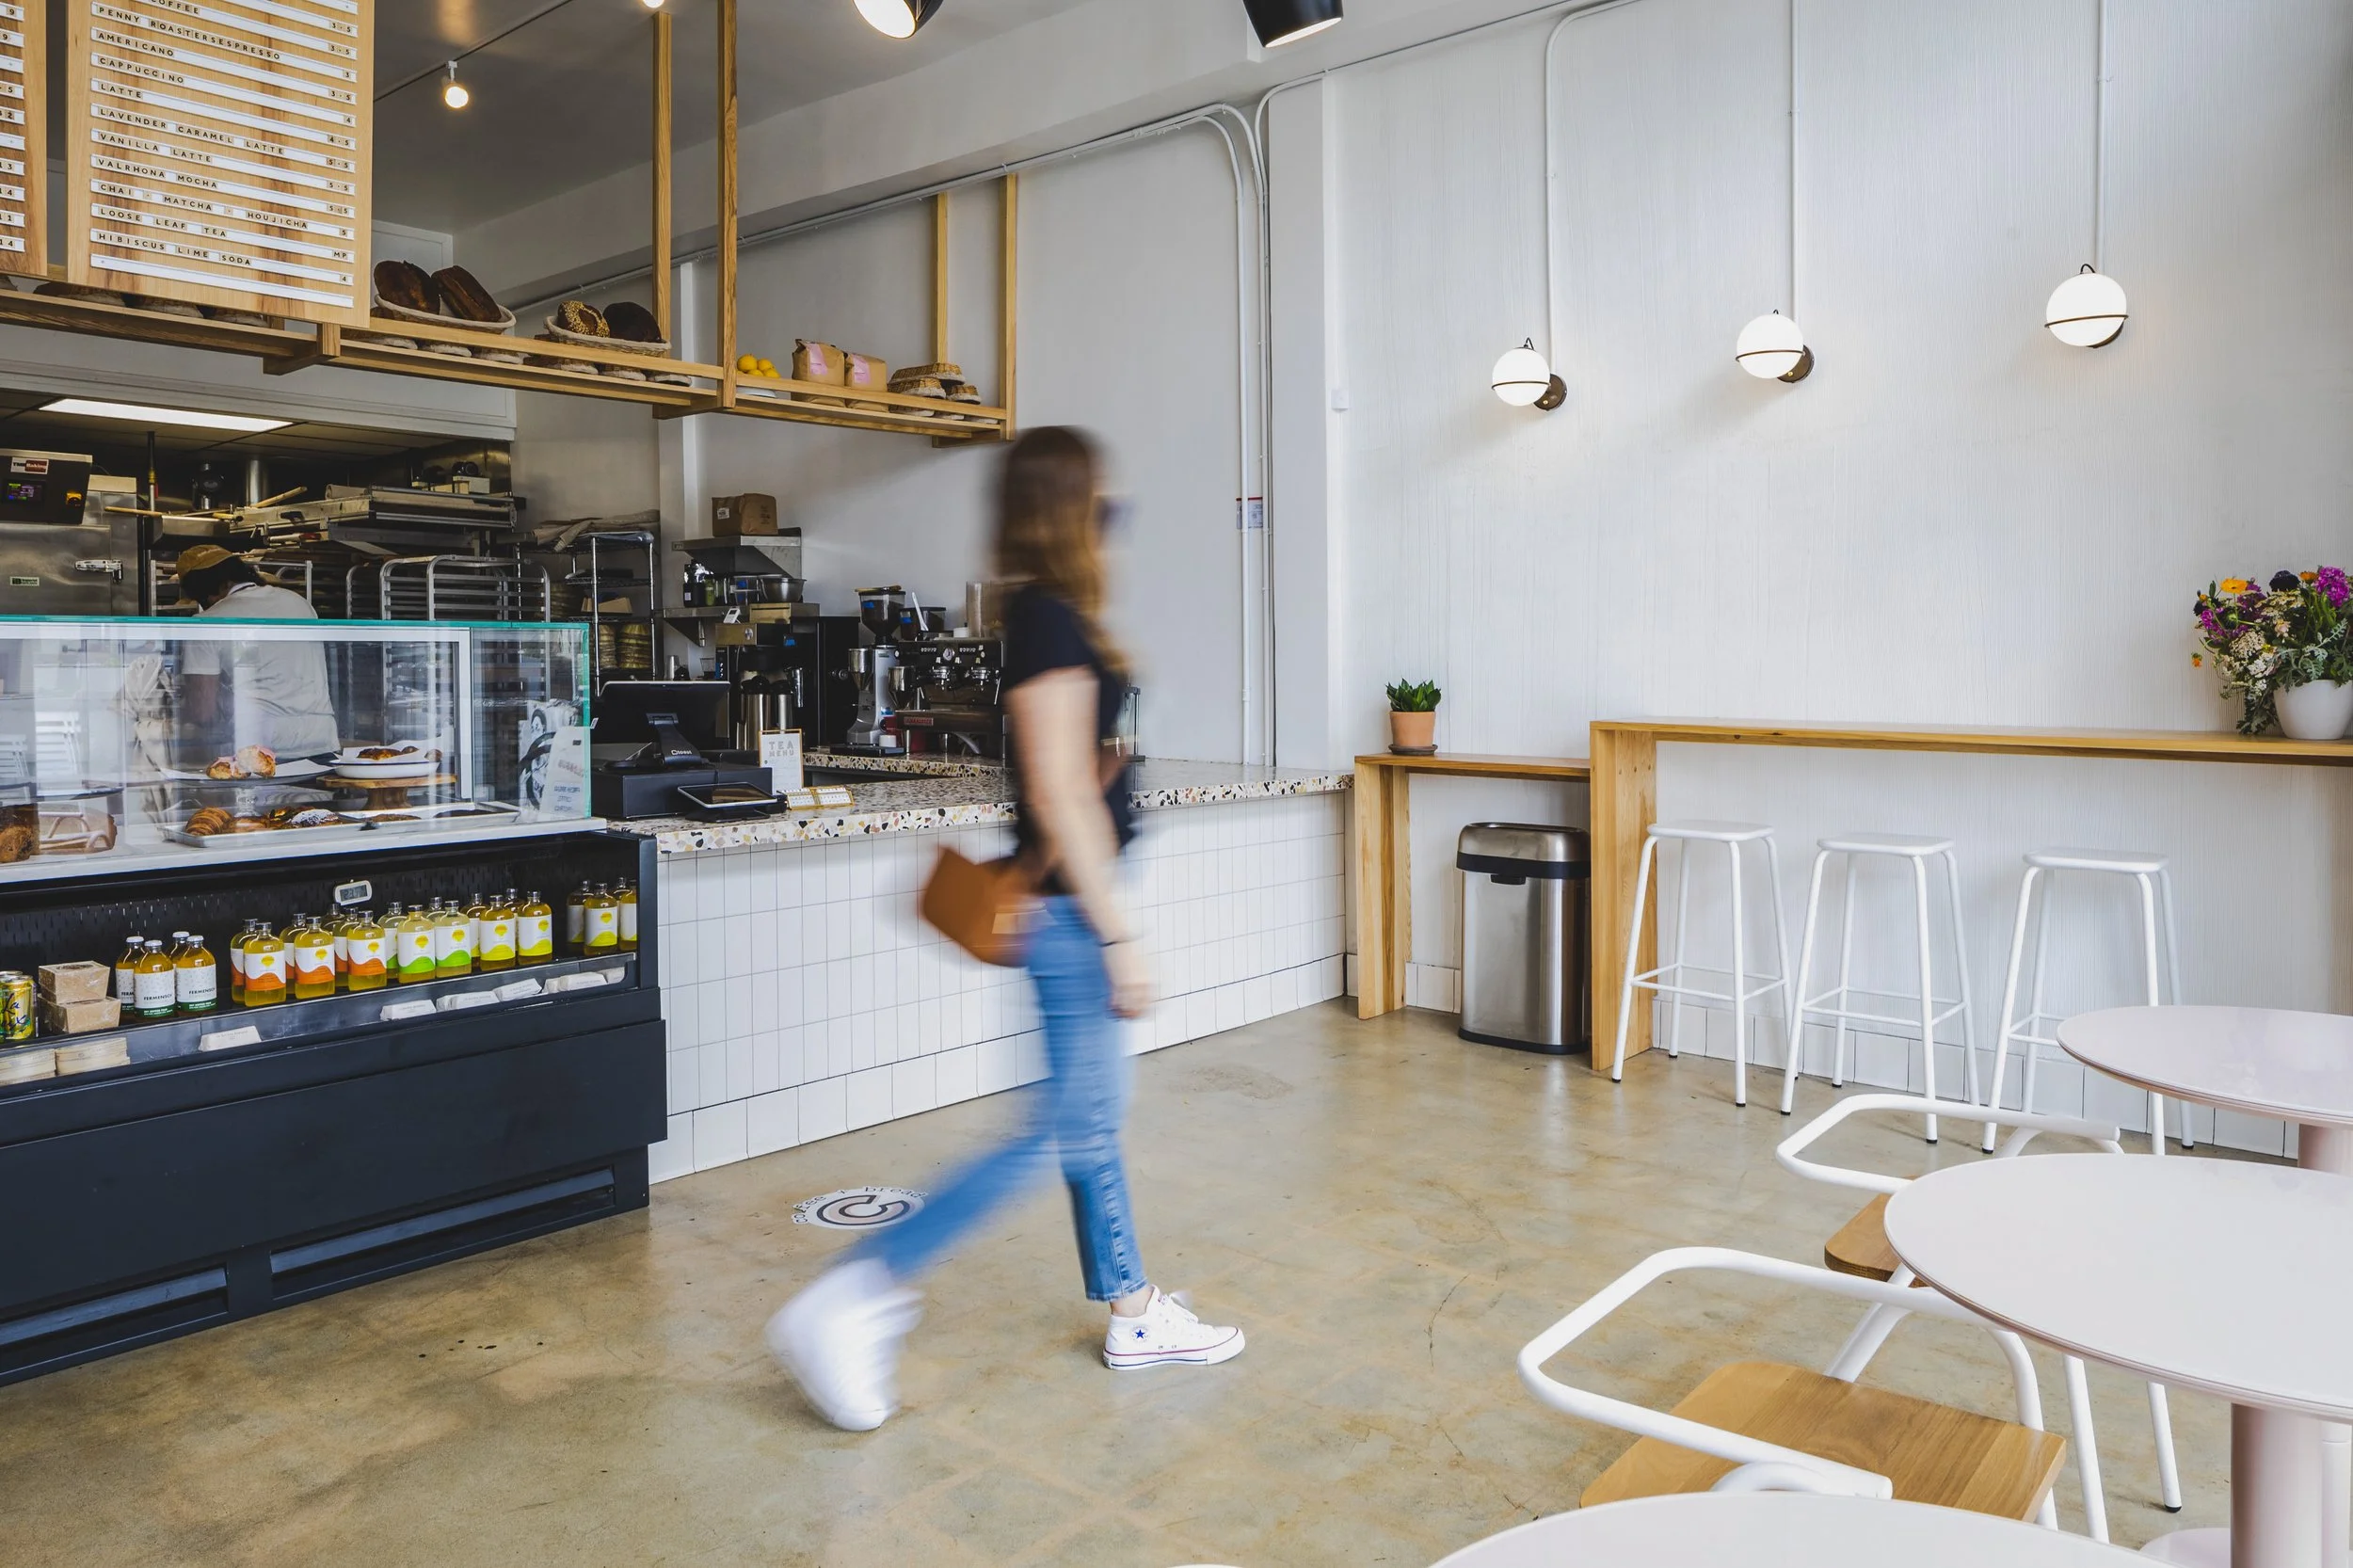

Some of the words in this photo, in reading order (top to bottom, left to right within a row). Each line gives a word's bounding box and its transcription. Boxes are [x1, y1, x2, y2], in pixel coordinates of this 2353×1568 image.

[99, 7, 140, 23] PENNY
[98, 33, 174, 56] AMERICANO
[100, 57, 184, 84] CAPPUCCINO
[101, 83, 141, 99] LATTE
[100, 108, 167, 128] LAVENDER
[178, 126, 232, 143] CARAMEL
[246, 141, 283, 154] LATTE
[100, 133, 159, 152] VANILLA
[173, 149, 212, 162] LATTE
[98, 158, 166, 178] VALRHONA
[177, 174, 218, 188] MOCHA
[100, 184, 132, 196] CHAI
[164, 196, 212, 211] MATCHA
[248, 212, 308, 229] HOUJICHA
[101, 208, 141, 221] LOOSE
[156, 217, 186, 230] LEAF
[203, 227, 226, 237] TEA
[98, 232, 165, 250] HIBISCUS
[178, 247, 208, 258] LIME
[221, 254, 251, 265] SODA
[768, 740, 794, 750] TEA
